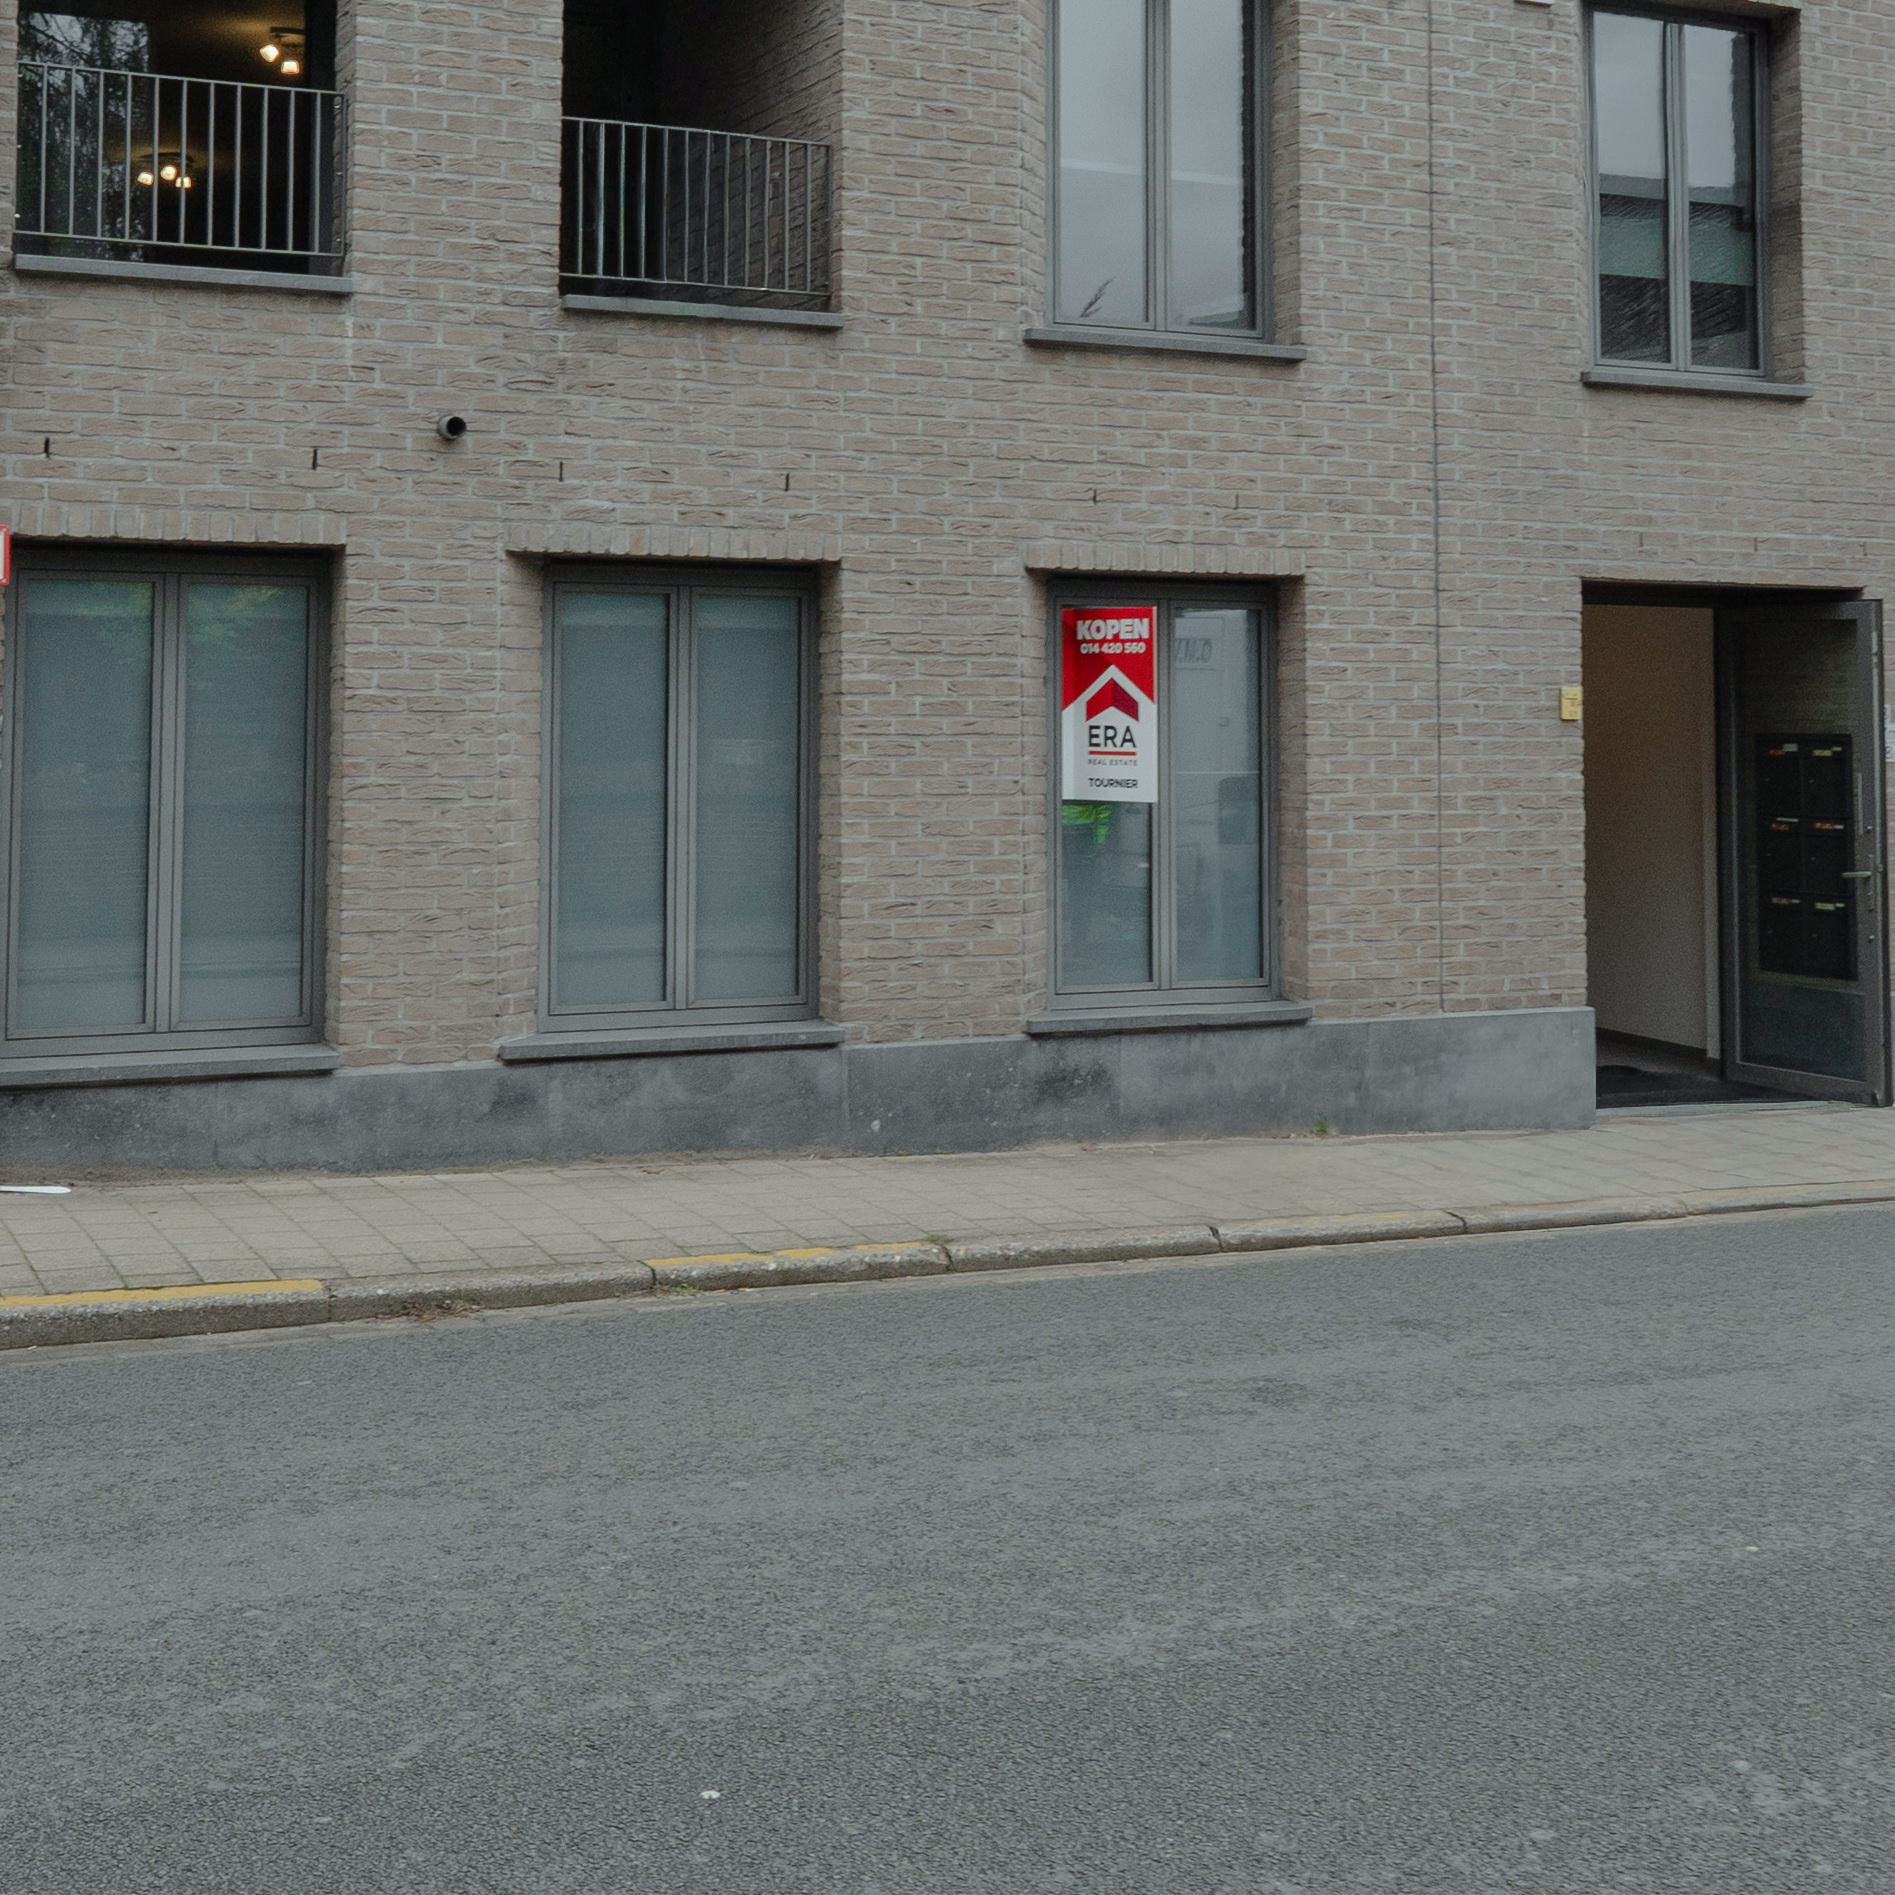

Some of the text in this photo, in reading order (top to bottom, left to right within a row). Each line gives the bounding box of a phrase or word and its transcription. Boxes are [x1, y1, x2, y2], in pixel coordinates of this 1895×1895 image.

[1076, 618, 1150, 640] KOPEN
[1080, 642, 1099, 654] 014
[1101, 642, 1123, 654] 420
[1088, 725, 1137, 748] ERA
[1088, 758, 1138, 767] REAL ESTATE
[1088, 777, 1138, 789] TOURNIER
